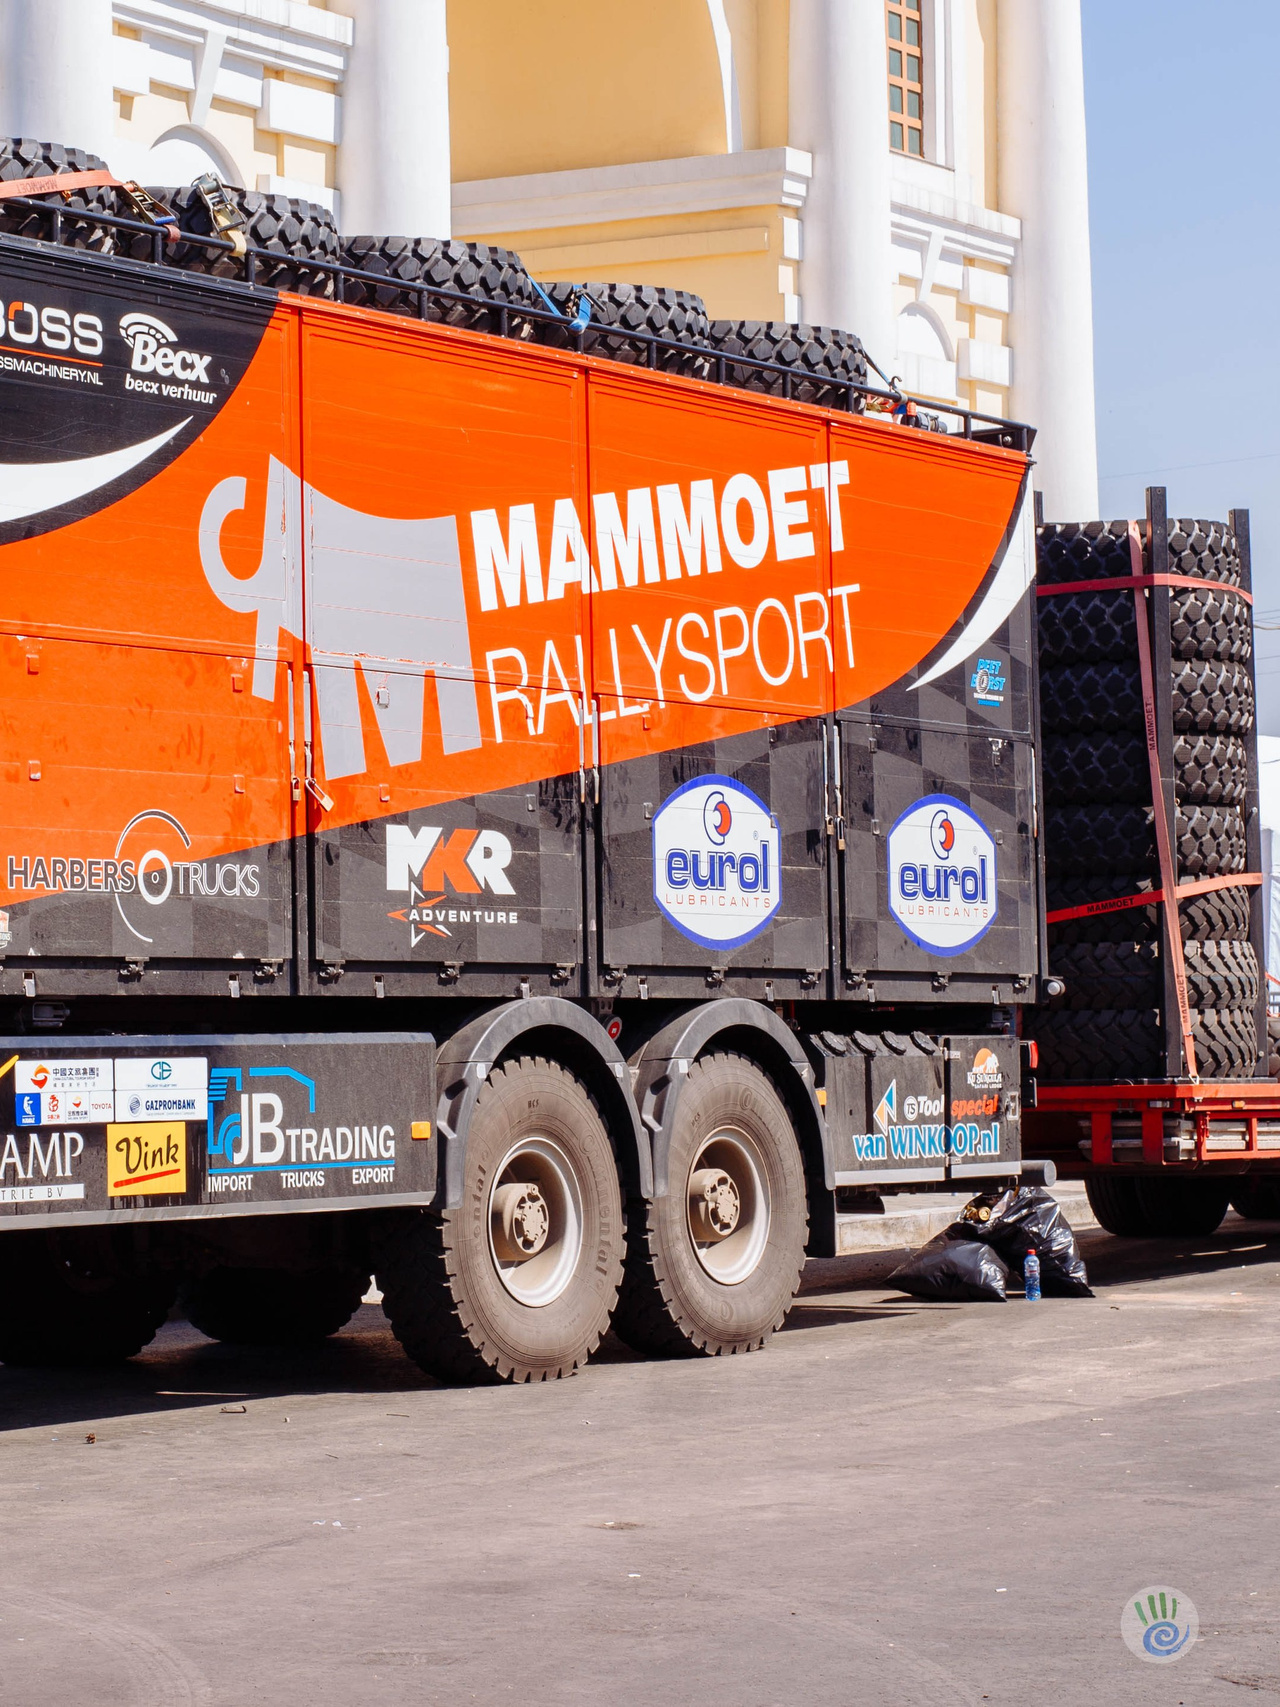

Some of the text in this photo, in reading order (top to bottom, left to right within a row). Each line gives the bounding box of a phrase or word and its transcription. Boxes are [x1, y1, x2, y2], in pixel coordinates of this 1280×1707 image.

[131, 333, 212, 384] Becx
[125, 374, 217, 404] becx verhuur
[469, 459, 850, 613] MAMMOET
[484, 583, 861, 744] RALLYSPORT
[1145, 700, 1156, 751] MAMMOET
[7, 856, 260, 896] HARBERS TRUCKS
[666, 839, 771, 894] eurol
[898, 855, 988, 904] eurol
[409, 909, 518, 924] ADVENTURE
[666, 894, 771, 908] LUBRICANTS
[899, 904, 989, 919] LUBRICANTS
[1087, 897, 1134, 913] MAMMOET
[145, 1099, 196, 1111] GAZPROMBANK
[917, 1094, 945, 1117] Tool
[951, 1094, 999, 1120] special
[116, 1134, 179, 1174] Vink
[285, 1125, 396, 1162] TRADING
[852, 1122, 1000, 1161] van WINKOOP.nl
[47, 1186, 65, 1199] BV
[208, 1167, 395, 1192] IMPORT TRUCKS EXPORT
